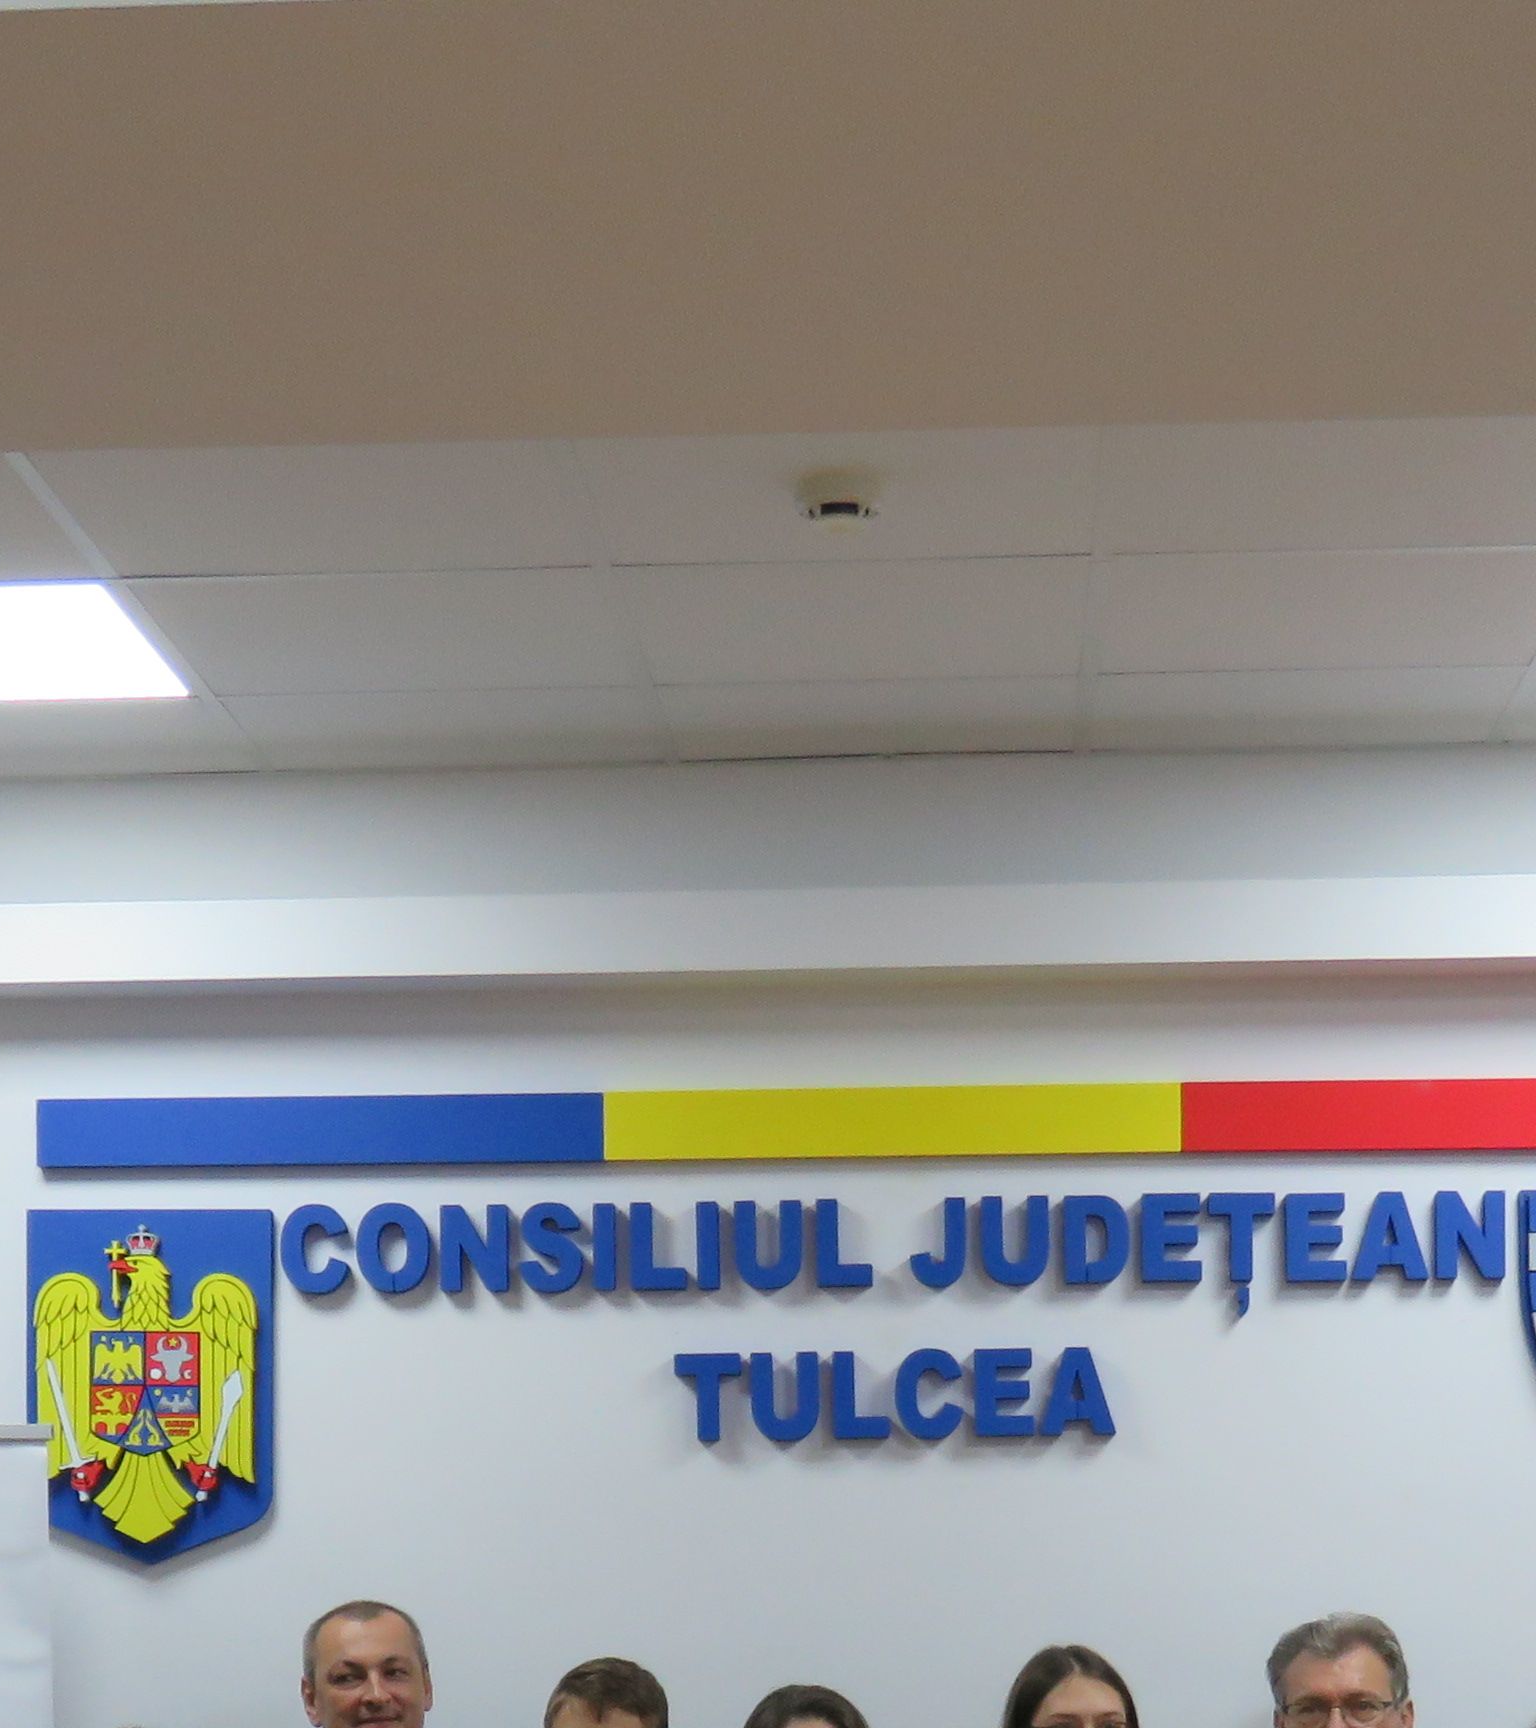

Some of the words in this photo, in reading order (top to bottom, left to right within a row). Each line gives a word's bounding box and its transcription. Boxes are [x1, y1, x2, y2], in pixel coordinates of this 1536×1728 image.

[281, 1196, 876, 1296] CONSILIUL
[908, 1190, 1510, 1317] JUDEȚEAN
[672, 1346, 1117, 1443] TULCEA
